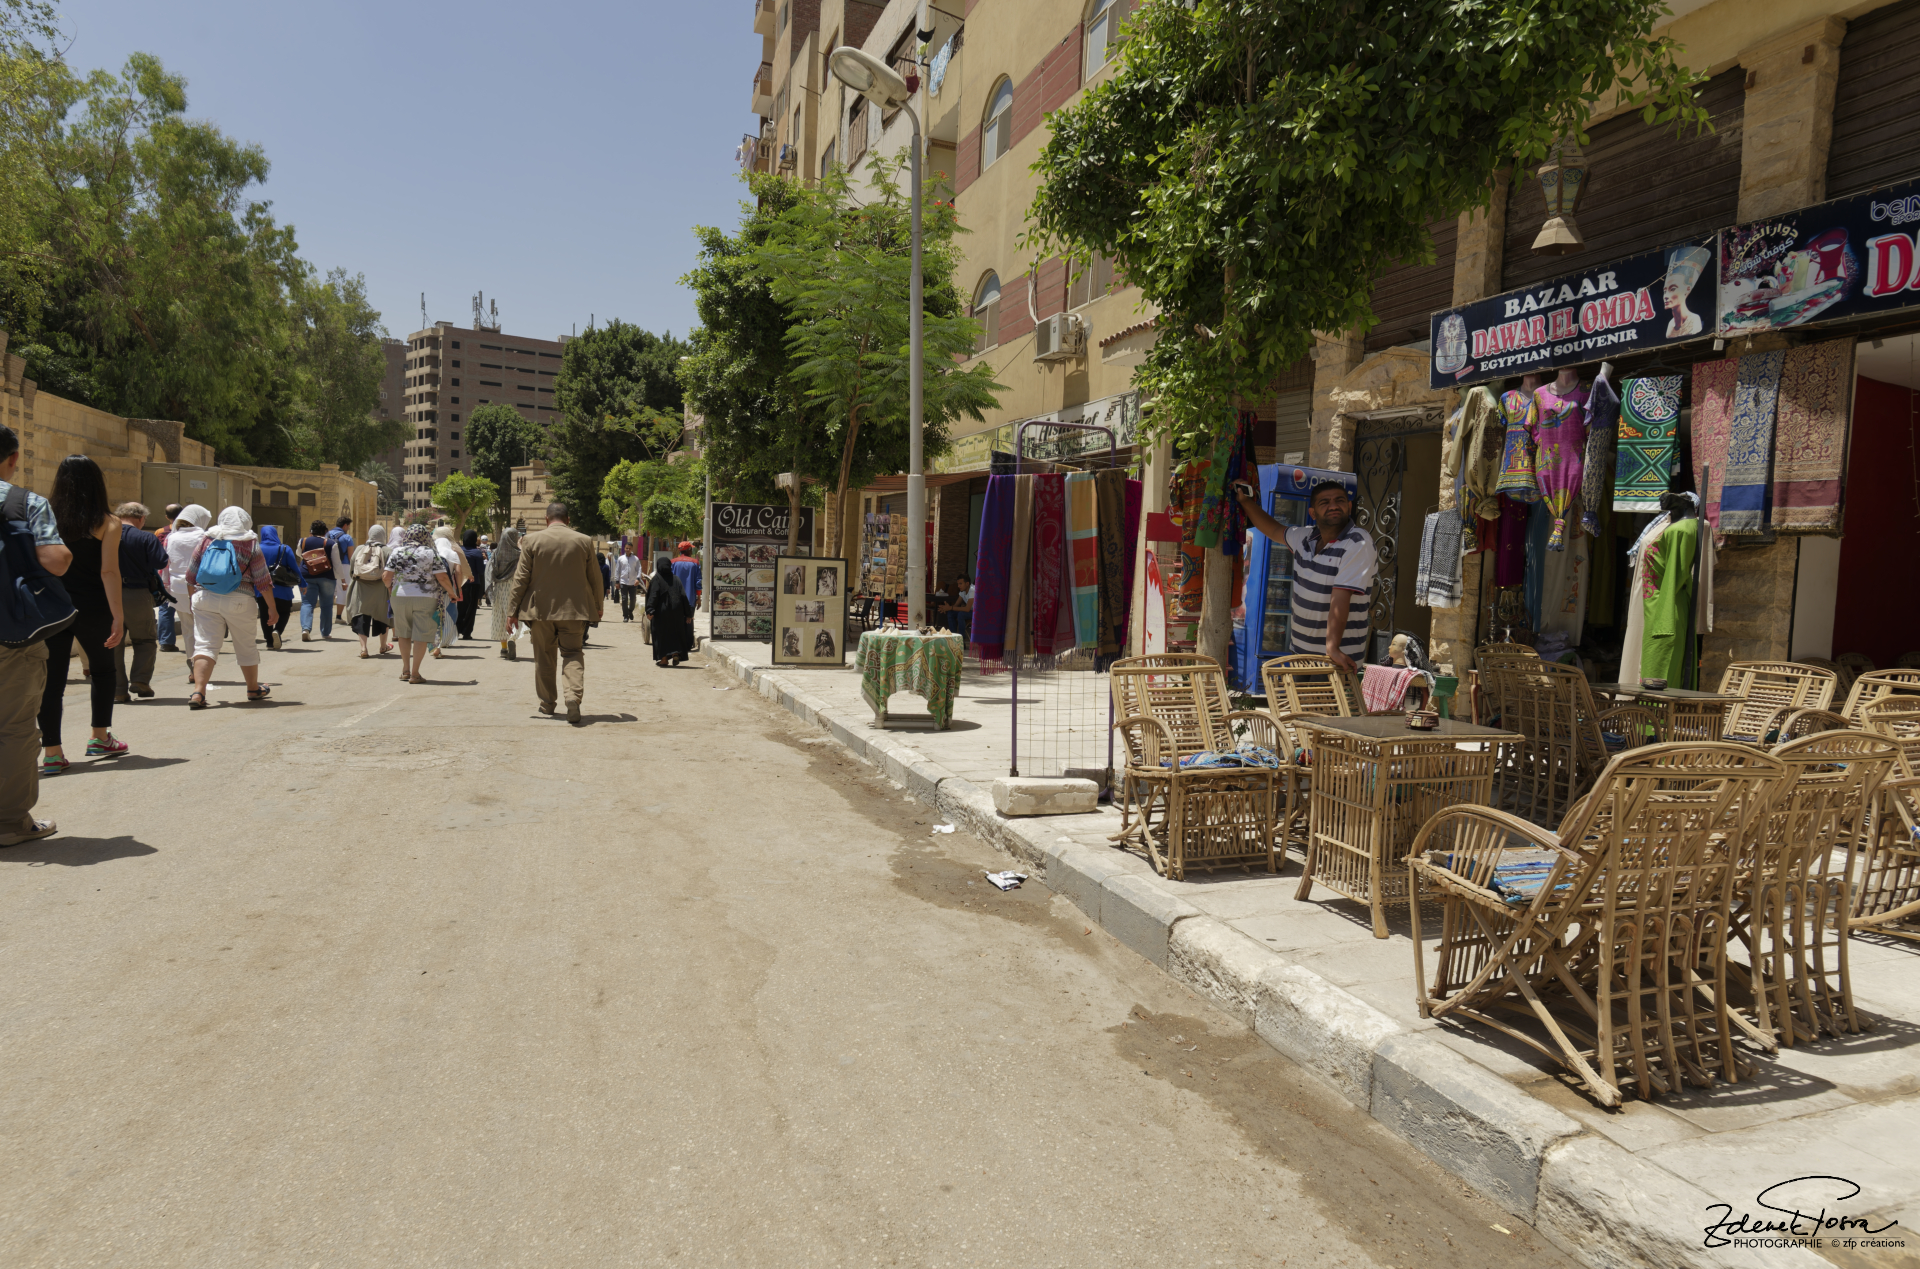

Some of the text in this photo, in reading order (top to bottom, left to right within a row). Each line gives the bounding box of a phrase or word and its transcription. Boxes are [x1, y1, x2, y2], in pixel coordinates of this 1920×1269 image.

[1504, 271, 1619, 318] BAZAAR
[1471, 287, 1656, 359] DAWAR EL OMDA
[1480, 329, 1638, 371] EGYPTIAN SOUVENIR
[718, 506, 805, 529] Old Caio
[725, 526, 765, 535] Restaurant
